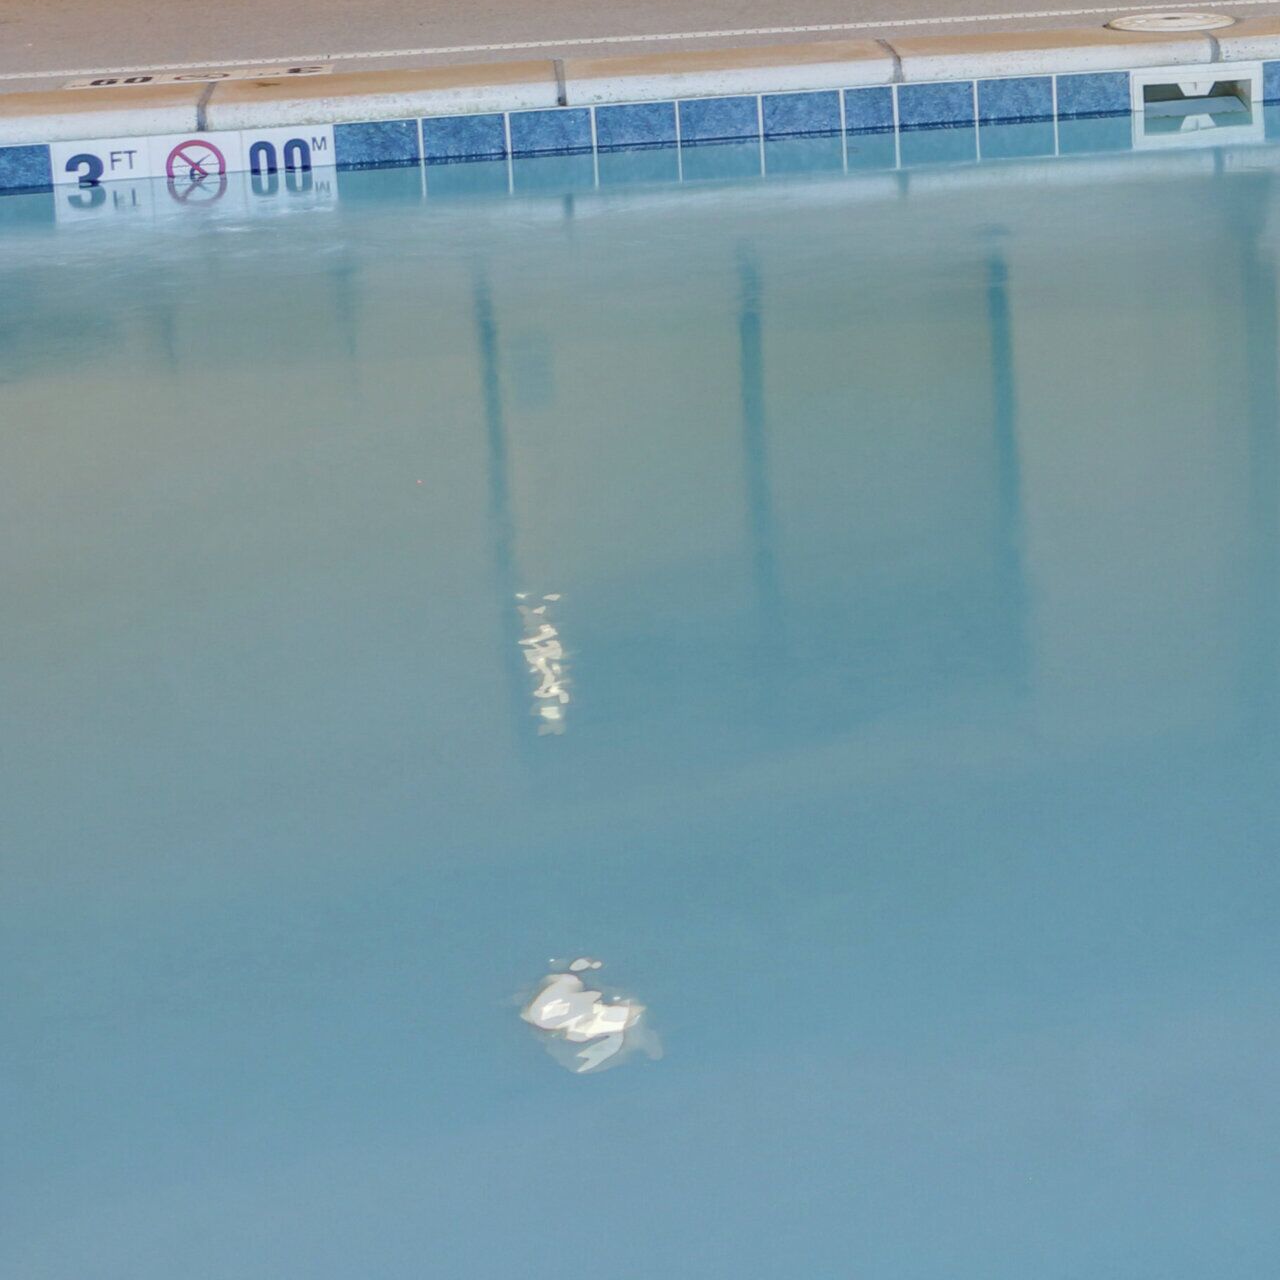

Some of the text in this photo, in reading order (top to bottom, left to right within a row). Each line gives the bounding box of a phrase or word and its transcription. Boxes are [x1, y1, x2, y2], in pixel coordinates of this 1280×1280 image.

[65, 153, 104, 188] 3
[110, 150, 138, 170] FT
[312, 136, 328, 152] M
